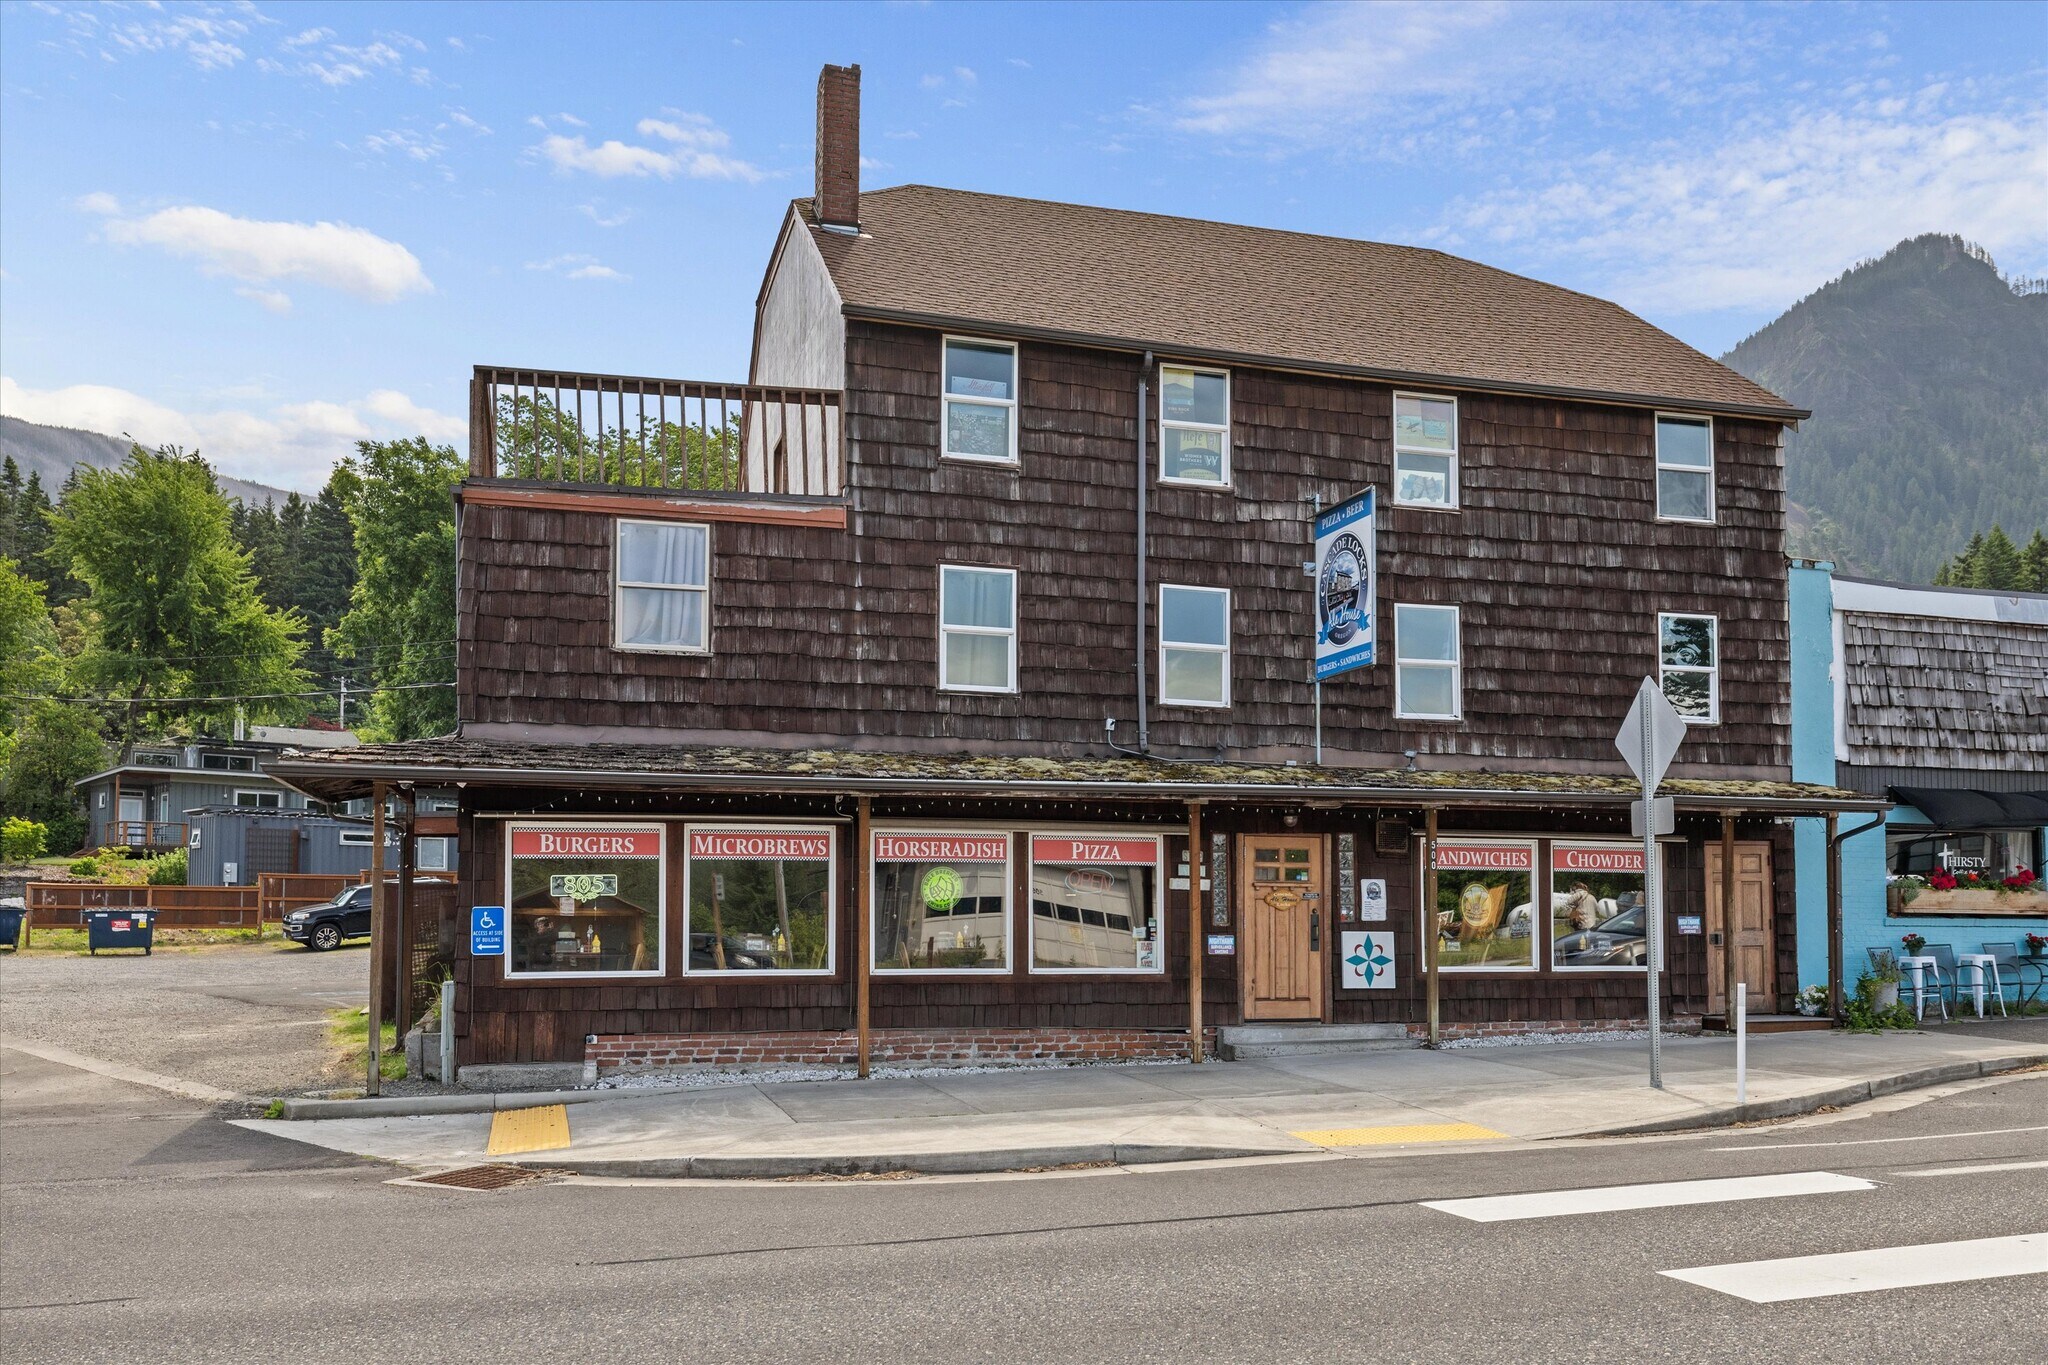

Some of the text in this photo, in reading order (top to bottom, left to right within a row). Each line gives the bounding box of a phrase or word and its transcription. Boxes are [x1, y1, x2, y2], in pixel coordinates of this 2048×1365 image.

[1321, 500, 1364, 530] PIZZA BEER
[1320, 537, 1367, 597] CASCADE LOCKS
[1327, 603, 1361, 632] Ale House
[1334, 627, 1352, 640] OREGON
[1317, 650, 1371, 674] BURGERS SANDWICHES
[539, 833, 635, 855] BURGERS
[694, 834, 827, 857] MICROBREWS
[877, 838, 1005, 859] HORSERADISH
[1071, 841, 1121, 861] PIZZA
[1437, 850, 1528, 867] ANDWICHES
[1566, 850, 1642, 869] CHOWDER
[563, 875, 605, 894] 805
[1068, 870, 1112, 891] OPEN
